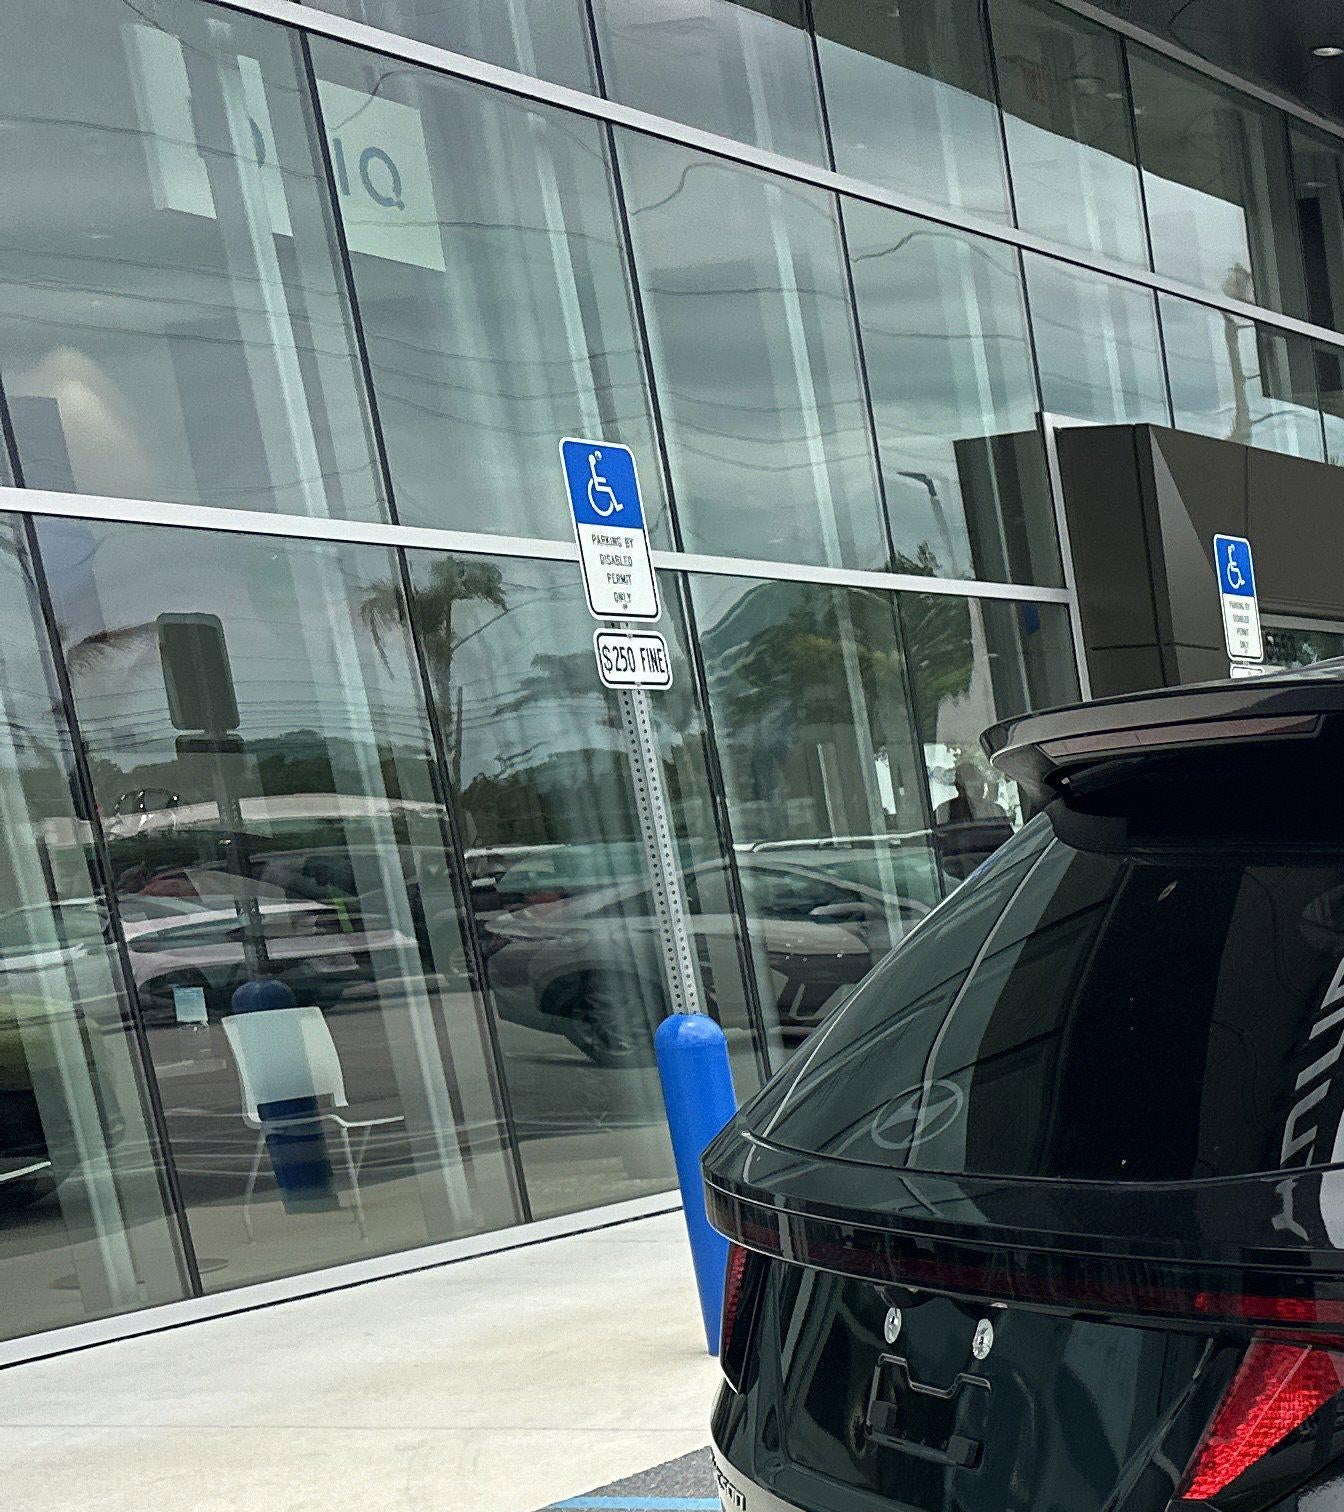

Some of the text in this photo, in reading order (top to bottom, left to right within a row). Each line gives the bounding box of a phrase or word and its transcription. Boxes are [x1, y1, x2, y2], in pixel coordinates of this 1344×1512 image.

[591, 533, 634, 548] PARKING BY
[599, 553, 633, 567] DISABLED
[606, 572, 632, 585] PERMIT
[613, 591, 632, 603] ONLY
[602, 643, 666, 674] $250 FINE
